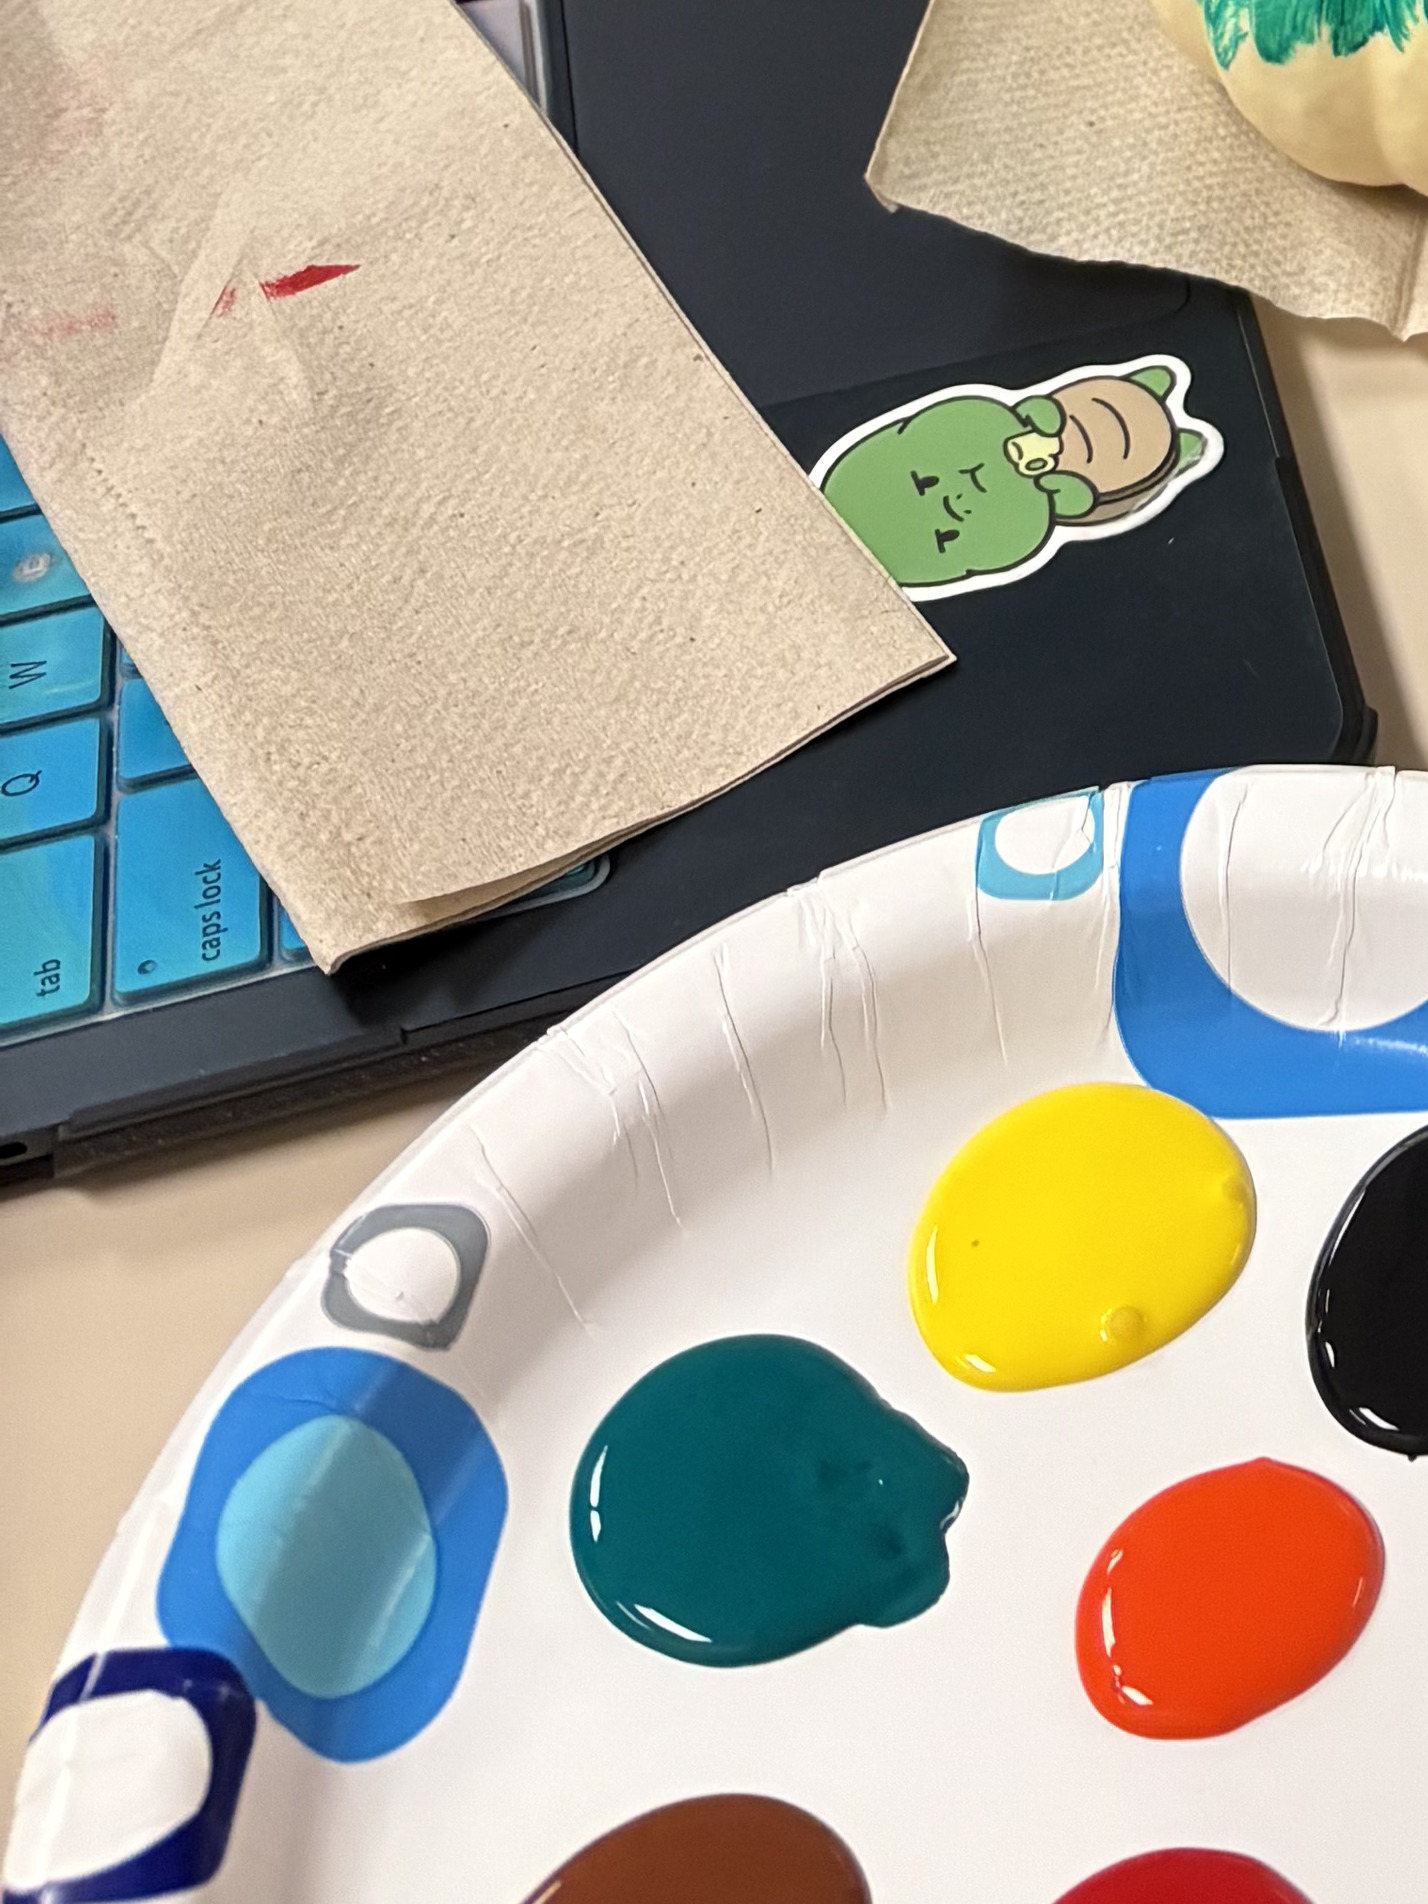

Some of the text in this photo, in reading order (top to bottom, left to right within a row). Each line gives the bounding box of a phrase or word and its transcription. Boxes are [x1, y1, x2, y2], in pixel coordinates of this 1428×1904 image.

[8, 660, 47, 690] W
[1, 770, 43, 797] Q
[194, 859, 228, 962] caps lock
[34, 958, 61, 998] tab
